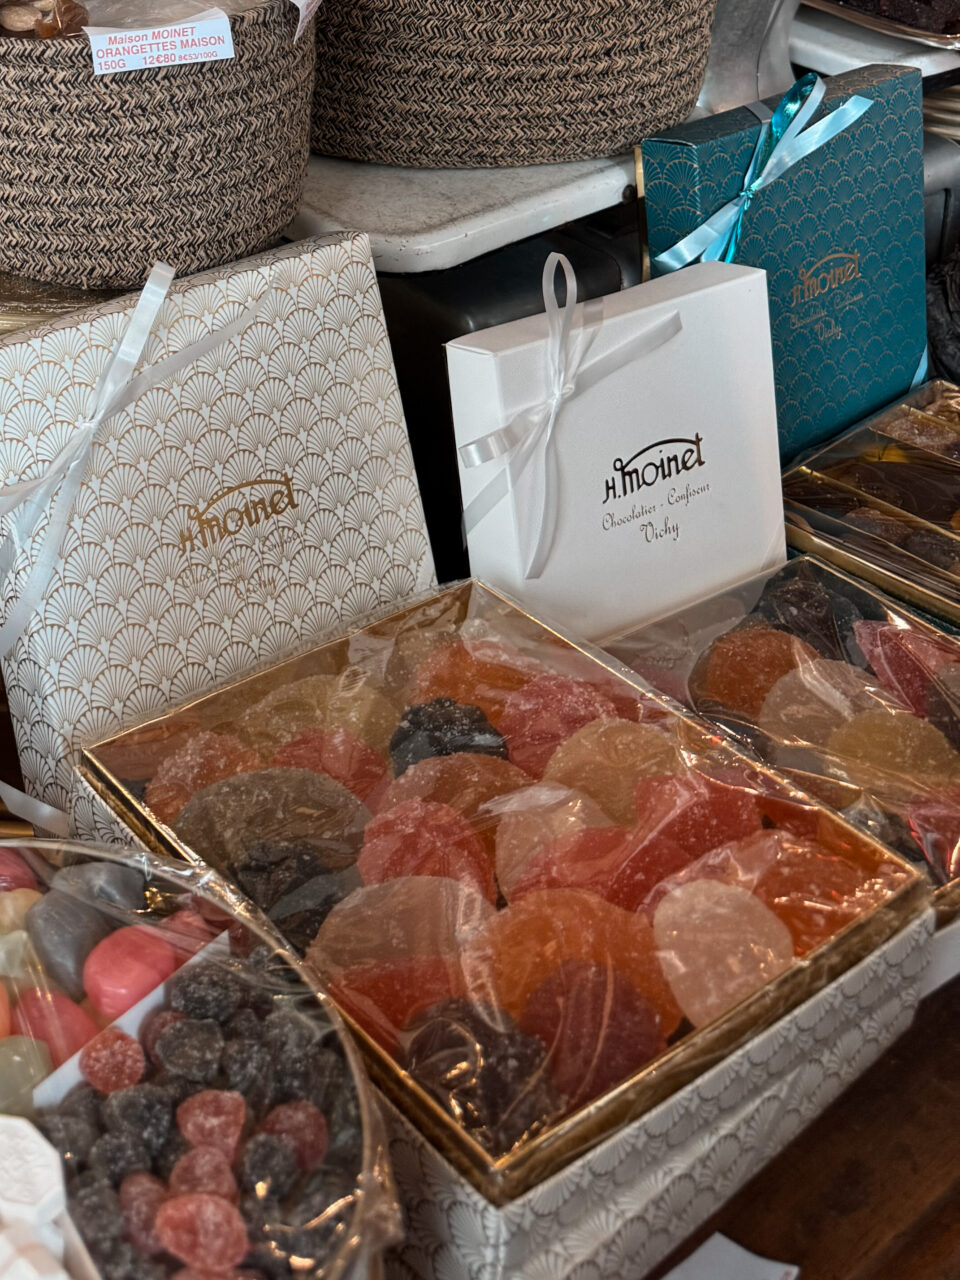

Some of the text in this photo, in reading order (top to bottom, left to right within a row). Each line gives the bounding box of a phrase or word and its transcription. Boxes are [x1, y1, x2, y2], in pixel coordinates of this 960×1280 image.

[96, 35, 226, 60] ORANGETTES MAISON
[108, 26, 197, 46] Maison MOINET
[97, 50, 218, 71] 150G 12€80 8€53/100G
[602, 483, 710, 531] Chocolatier Confiseur
[640, 516, 680, 543] Vichy
